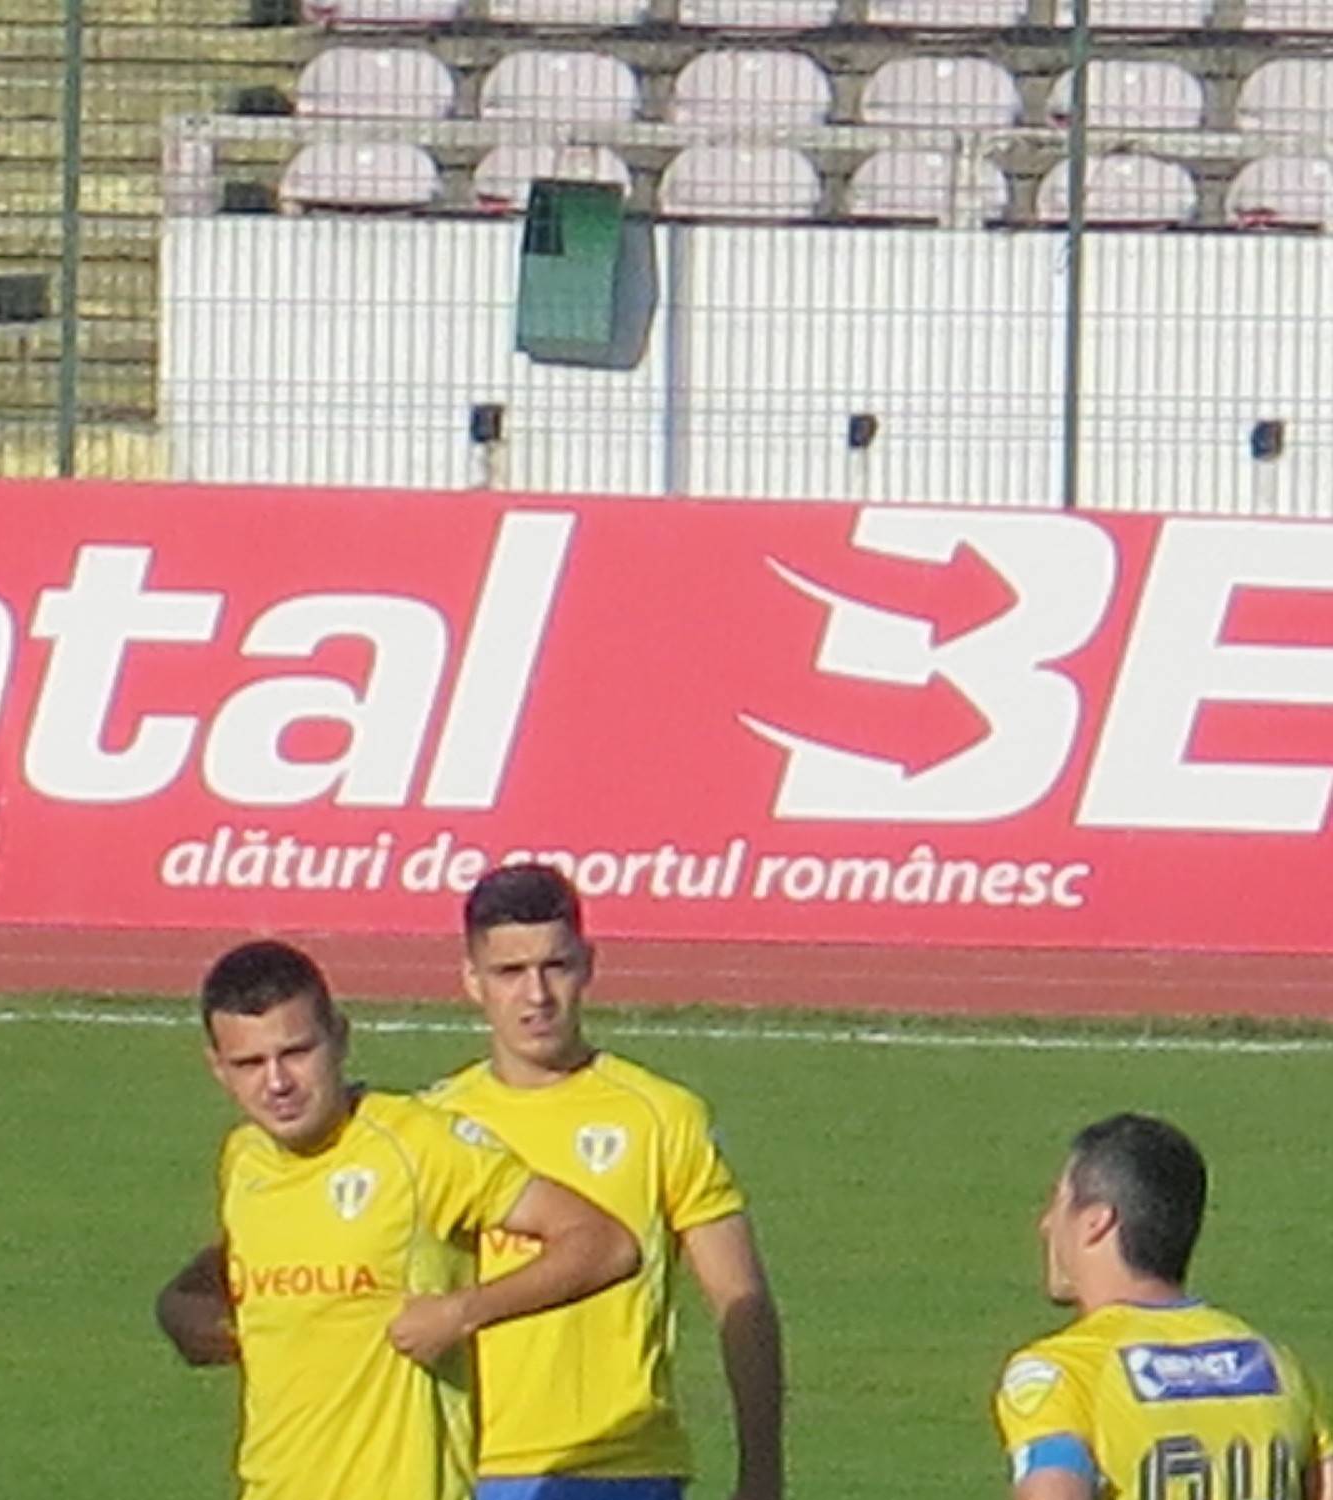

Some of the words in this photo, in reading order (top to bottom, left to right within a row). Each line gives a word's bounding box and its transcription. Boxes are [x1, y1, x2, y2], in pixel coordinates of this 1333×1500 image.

[737, 505, 1333, 834] BE
[161, 825, 396, 890] alături
[400, 831, 487, 894] de
[752, 844, 1090, 906] românesc
[251, 1263, 379, 1296] VEOLIA
